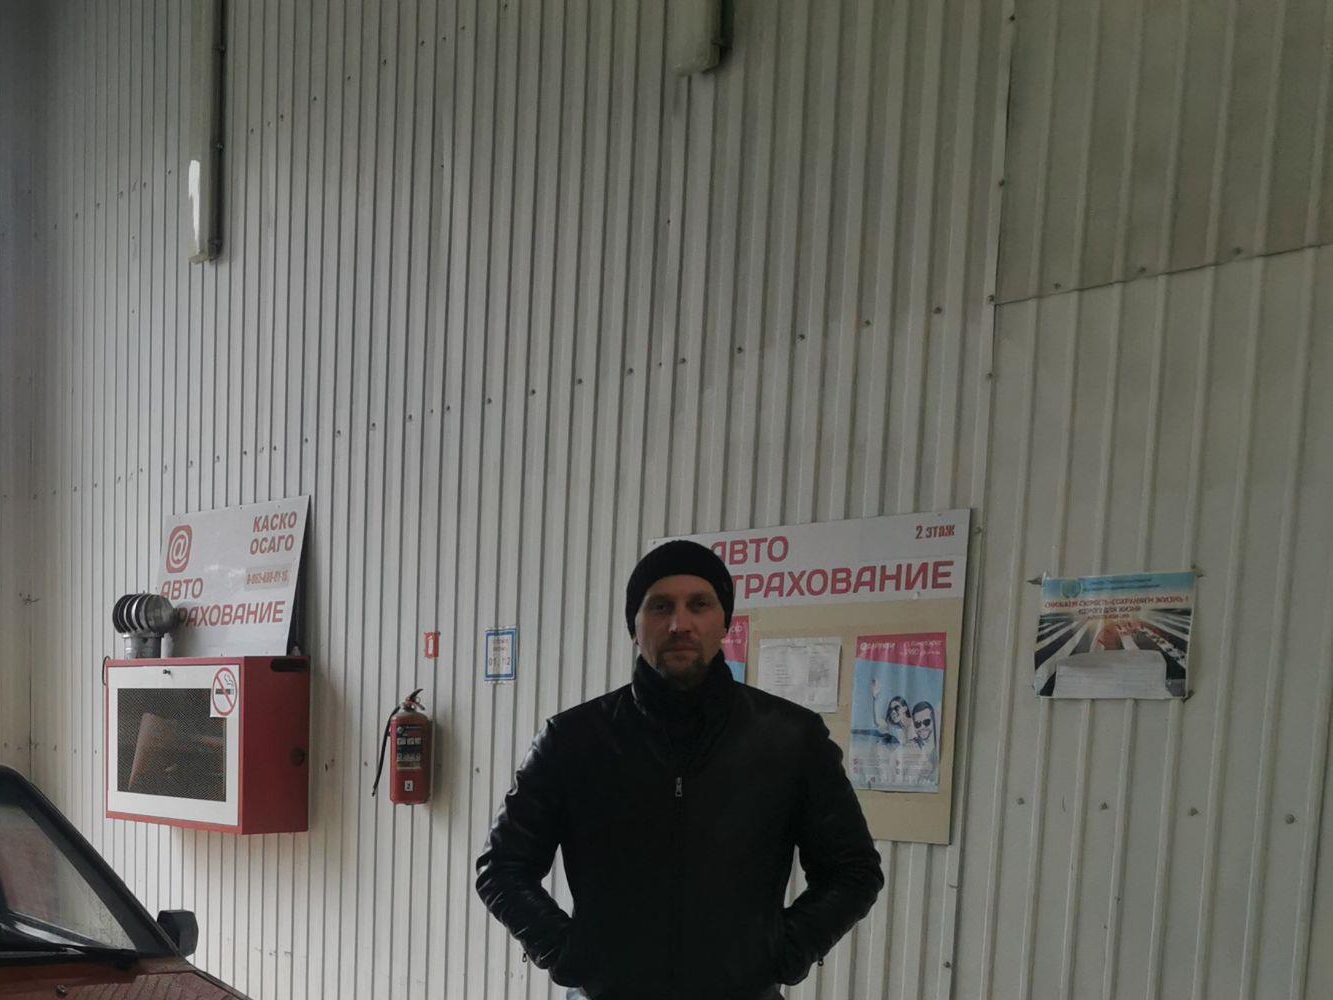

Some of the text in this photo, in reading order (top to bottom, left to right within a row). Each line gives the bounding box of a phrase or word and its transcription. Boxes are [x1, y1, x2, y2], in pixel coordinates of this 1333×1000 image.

[253, 511, 297, 533] КАСКО
[915, 524, 955, 539] 2 этаж
[250, 534, 294, 555] ОСАГО
[710, 536, 789, 565] АВТО
[160, 577, 203, 600] АВТО
[732, 560, 954, 599] ТРАХОВАНИЕ
[178, 600, 285, 628] РАХОВАНИЕ
